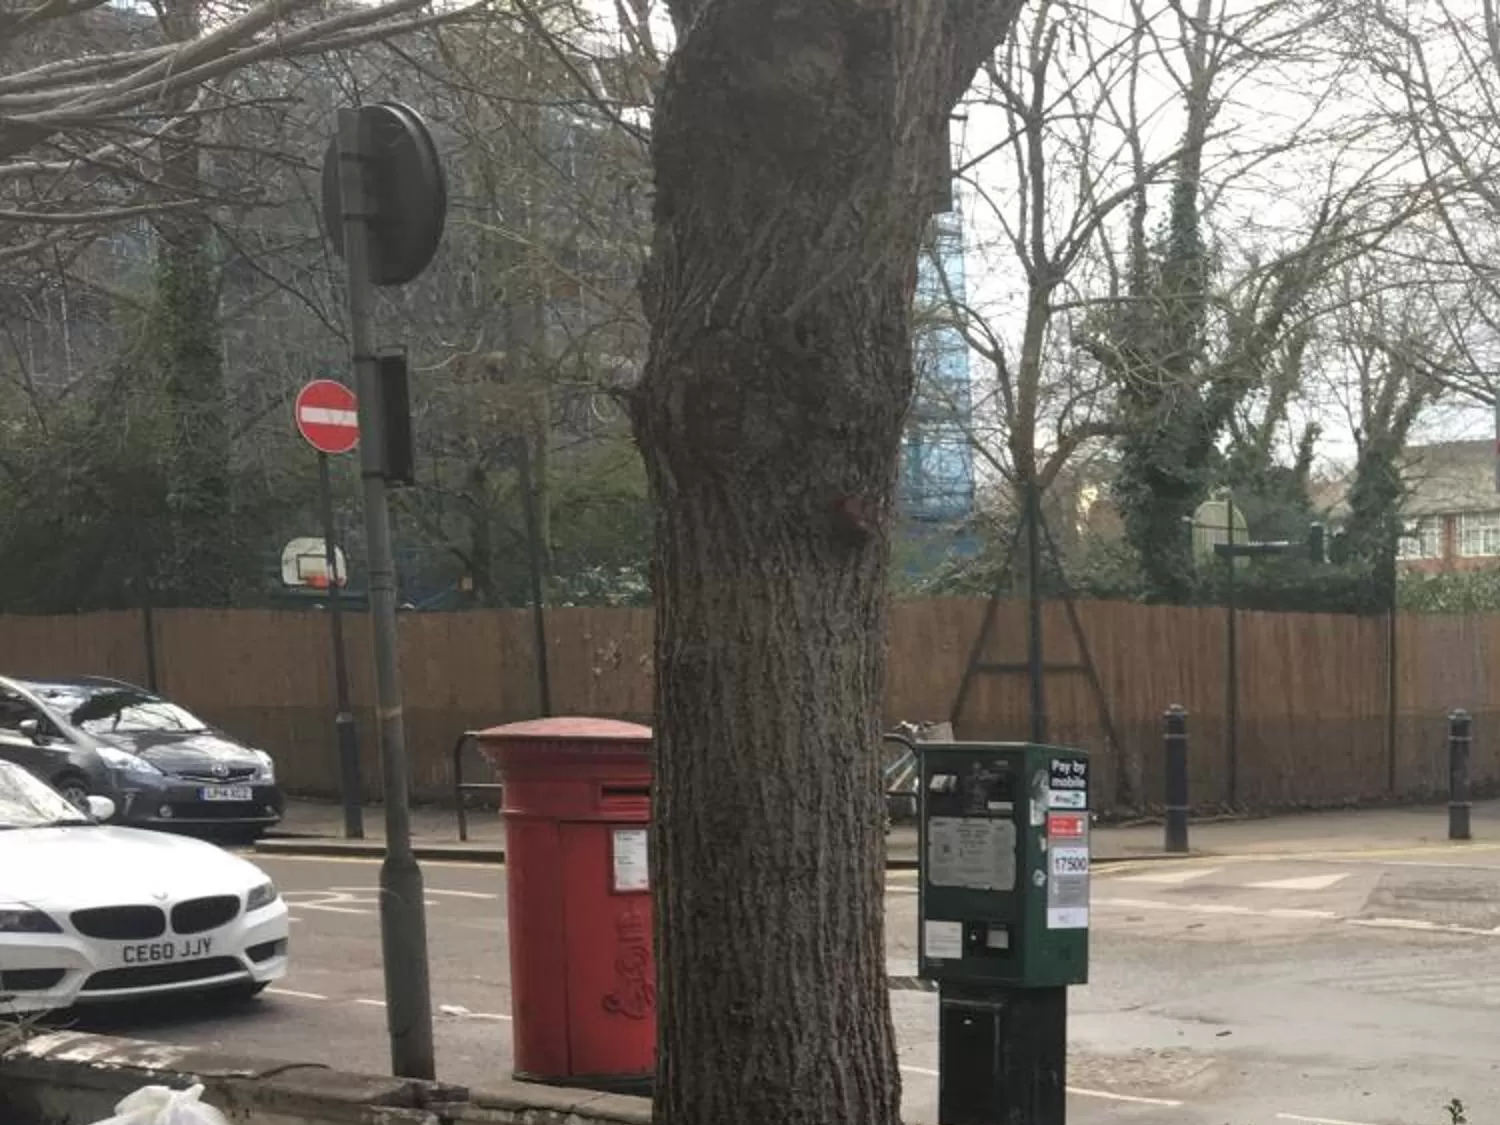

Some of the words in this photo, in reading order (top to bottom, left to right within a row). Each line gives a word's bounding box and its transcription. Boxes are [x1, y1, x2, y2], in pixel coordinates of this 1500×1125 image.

[1052, 759, 1071, 774] Pay
[1072, 760, 1086, 776] by
[1051, 776, 1086, 788] mobile
[1055, 856, 1087, 872] 17500
[123, 942, 174, 963] CE60
[179, 937, 212, 957] JJY
